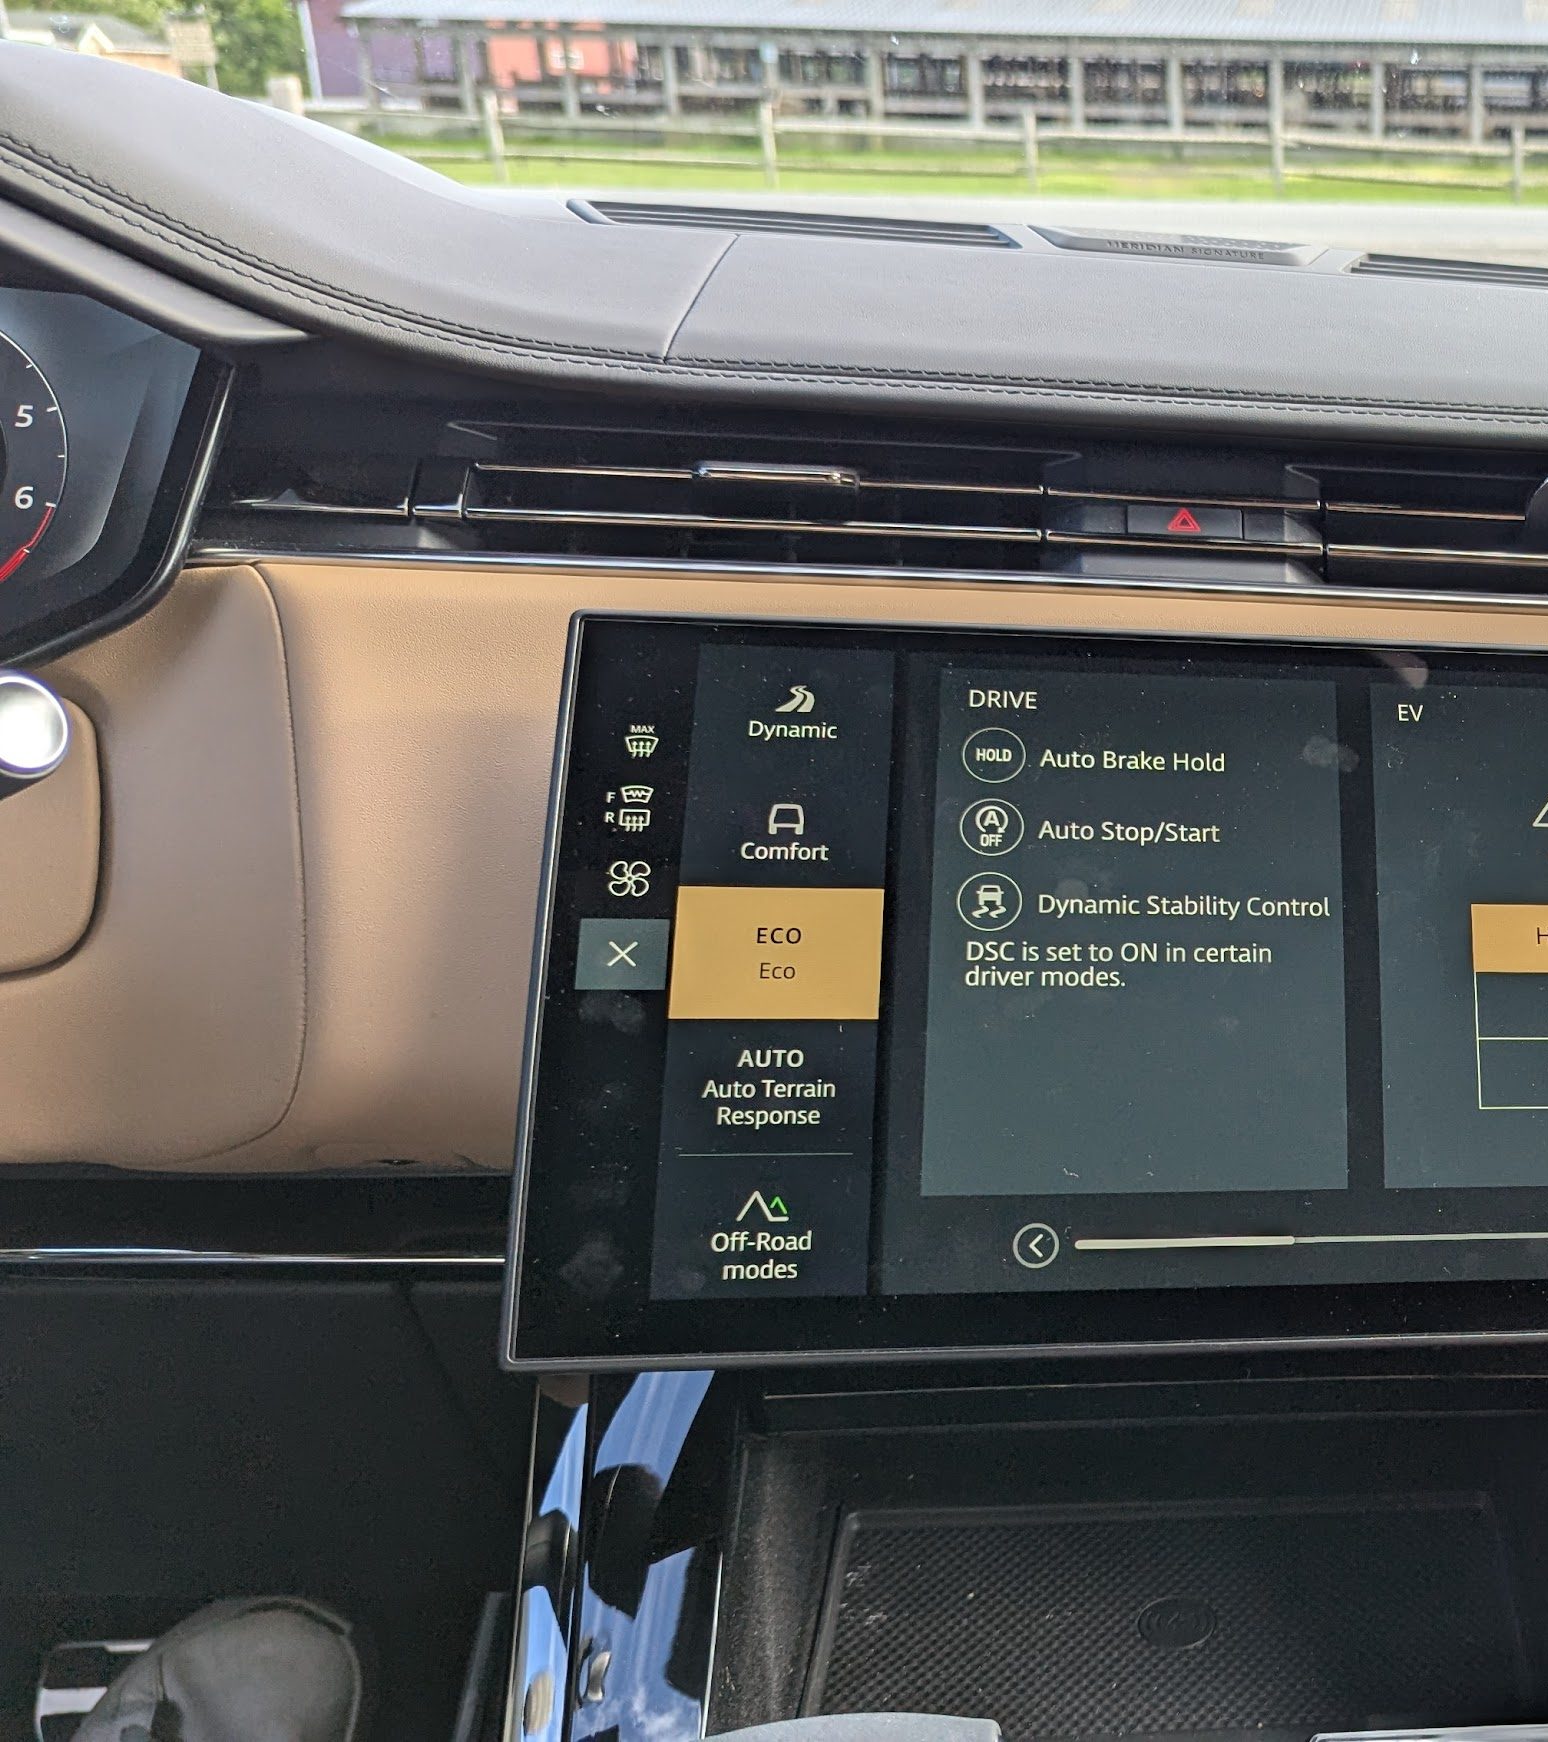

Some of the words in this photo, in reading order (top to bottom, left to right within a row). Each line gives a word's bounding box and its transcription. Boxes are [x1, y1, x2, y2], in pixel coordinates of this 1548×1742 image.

[1191, 247, 1265, 260] SIGNATURE
[15, 405, 33, 427] 5
[14, 486, 33, 509] 6
[969, 690, 1037, 709] DRIVE
[1397, 704, 1424, 722] EV
[630, 725, 655, 734] MAX
[748, 721, 838, 741] Dynamic
[976, 748, 1012, 763] HOLD
[1040, 749, 1095, 768] Auto
[1102, 752, 1166, 771] Brake
[1173, 753, 1225, 772] Hold
[607, 792, 615, 804] F
[605, 812, 615, 824] R
[980, 834, 1002, 847] OFF
[1038, 821, 1094, 840] Auto
[1101, 822, 1221, 846] Stop/Start
[740, 842, 829, 861] Comfort
[1038, 894, 1140, 918] Dynamic
[1147, 896, 1240, 920] Stability
[1247, 898, 1330, 917] Control
[756, 928, 802, 944] ECO
[966, 942, 1014, 961] DSC
[1021, 942, 1038, 961] is
[1045, 945, 1082, 962] set
[1088, 944, 1112, 962] to
[1120, 944, 1158, 963] ON
[1166, 944, 1186, 963] in
[1193, 944, 1272, 963] certain
[759, 963, 796, 980] Eco
[965, 966, 1034, 987] driver
[1041, 967, 1126, 987] modes.
[737, 1050, 804, 1067] AUTO
[701, 1080, 756, 1099] Auto
[761, 1079, 836, 1098] Terrain
[716, 1107, 821, 1129] Response
[710, 1230, 812, 1252] Off-Road
[721, 1259, 798, 1281] modes
